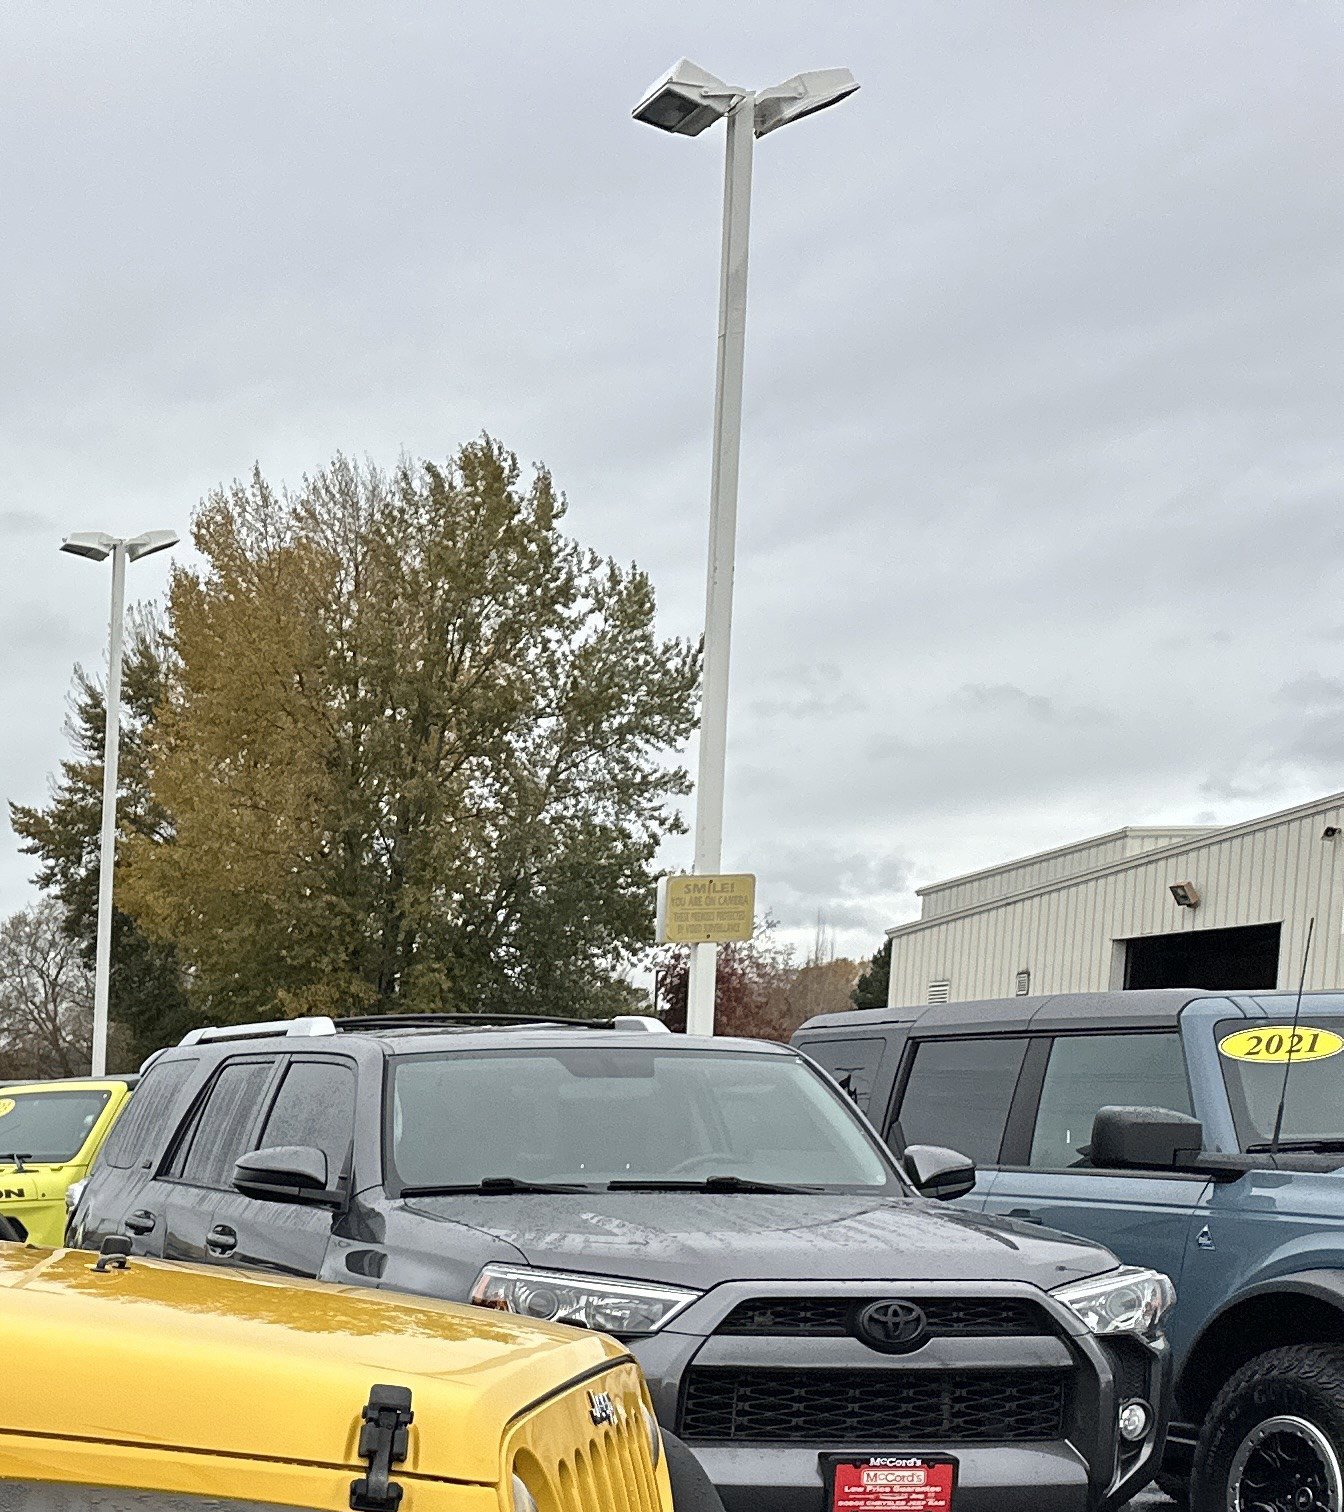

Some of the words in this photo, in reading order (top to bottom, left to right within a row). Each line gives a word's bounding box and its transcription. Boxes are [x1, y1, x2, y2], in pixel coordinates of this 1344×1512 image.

[684, 883, 735, 895] SMILE!
[1244, 1032, 1320, 1056] 2021
[869, 1457, 922, 1467] McCord's
[865, 1472, 923, 1483] McCord's
